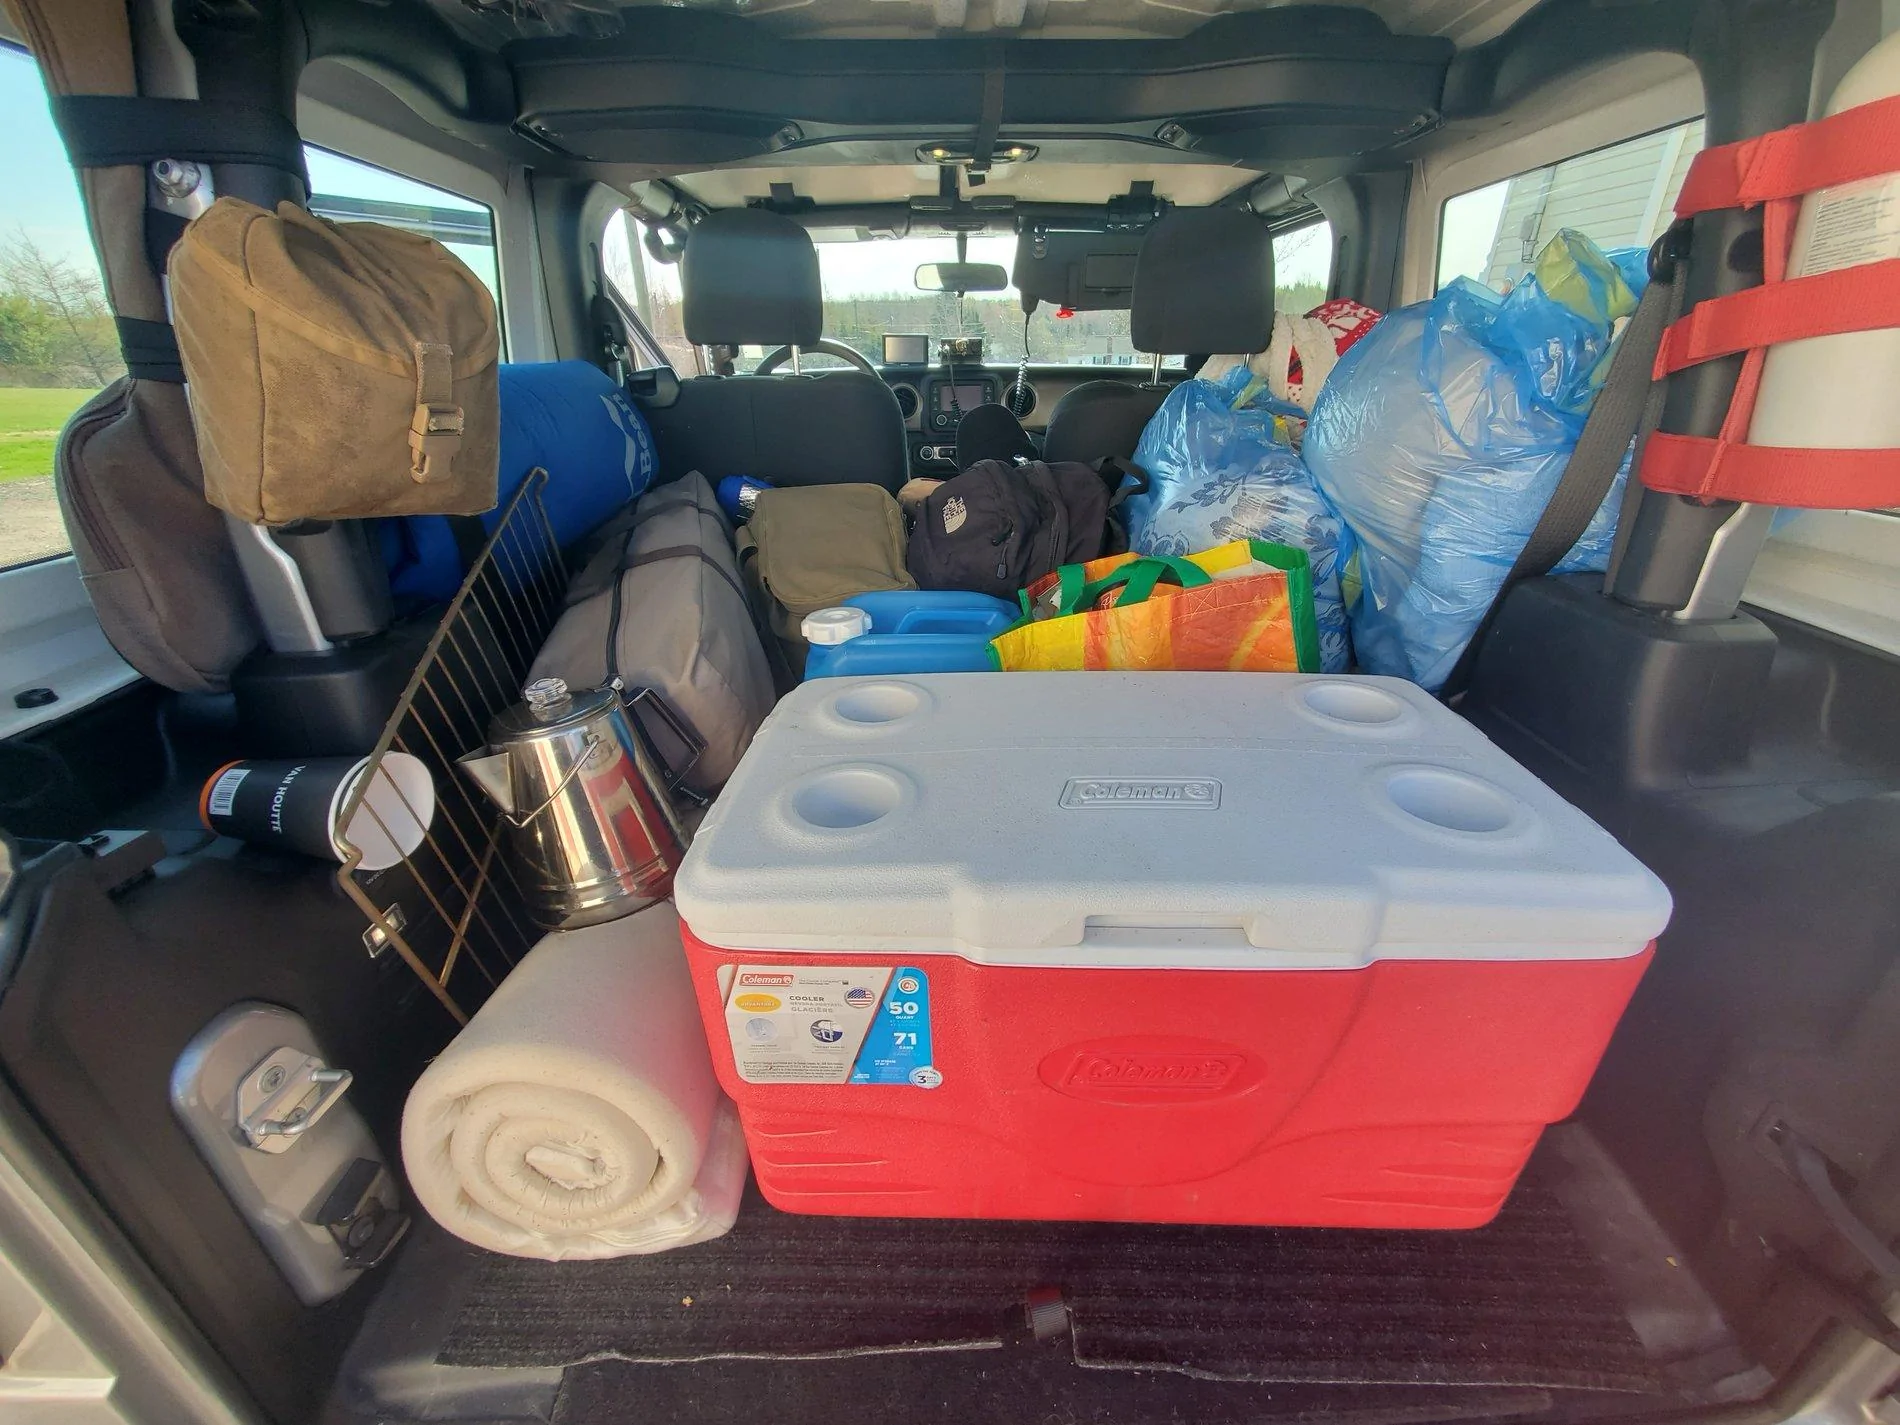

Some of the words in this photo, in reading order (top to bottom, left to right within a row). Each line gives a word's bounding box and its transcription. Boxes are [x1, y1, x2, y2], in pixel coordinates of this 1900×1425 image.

[612, 393, 651, 475] Bean
[282, 765, 306, 784] VAN
[1080, 782, 1181, 800] Coleman
[270, 786, 288, 834] HOUTTE
[742, 974, 783, 985] Coleman
[889, 1001, 919, 1015] 50
[893, 1032, 918, 1046] 71
[1086, 1057, 1200, 1082] Coleman
[917, 1075, 927, 1084] 3
